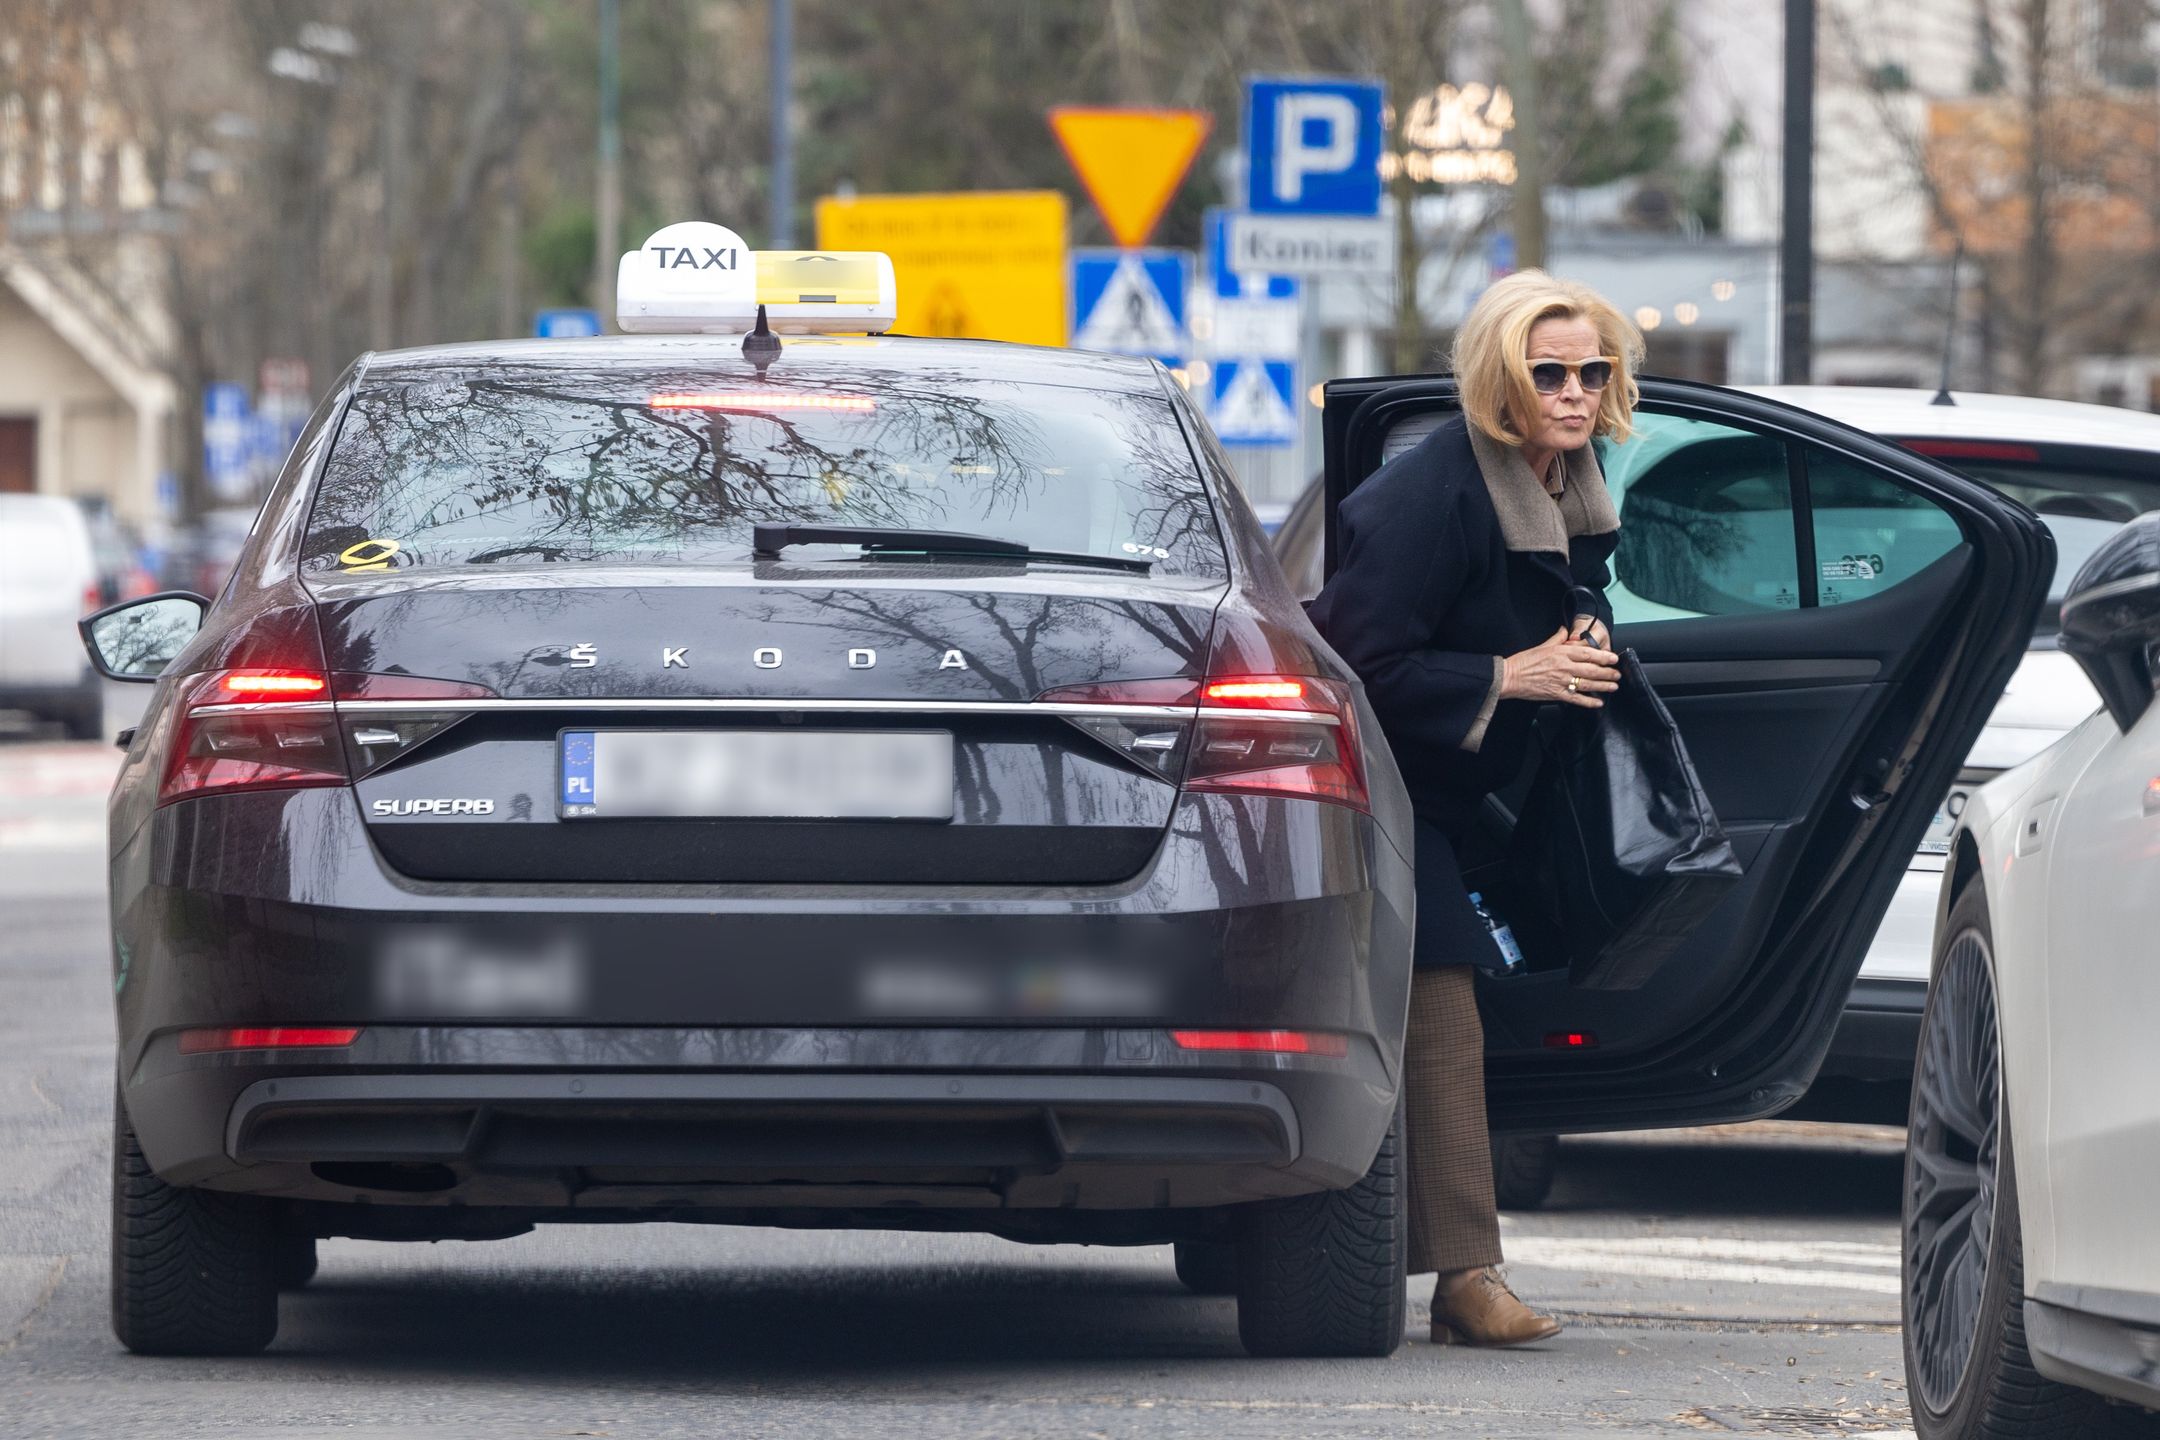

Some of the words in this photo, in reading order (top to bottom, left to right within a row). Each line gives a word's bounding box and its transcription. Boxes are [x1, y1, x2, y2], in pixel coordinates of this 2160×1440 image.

[1274, 93, 1359, 202] P
[1246, 229, 1376, 262] Koniec
[651, 247, 737, 270] TAXI
[569, 642, 969, 670] ŠKODA
[567, 777, 592, 794] PL
[373, 798, 495, 816] SUPERB
